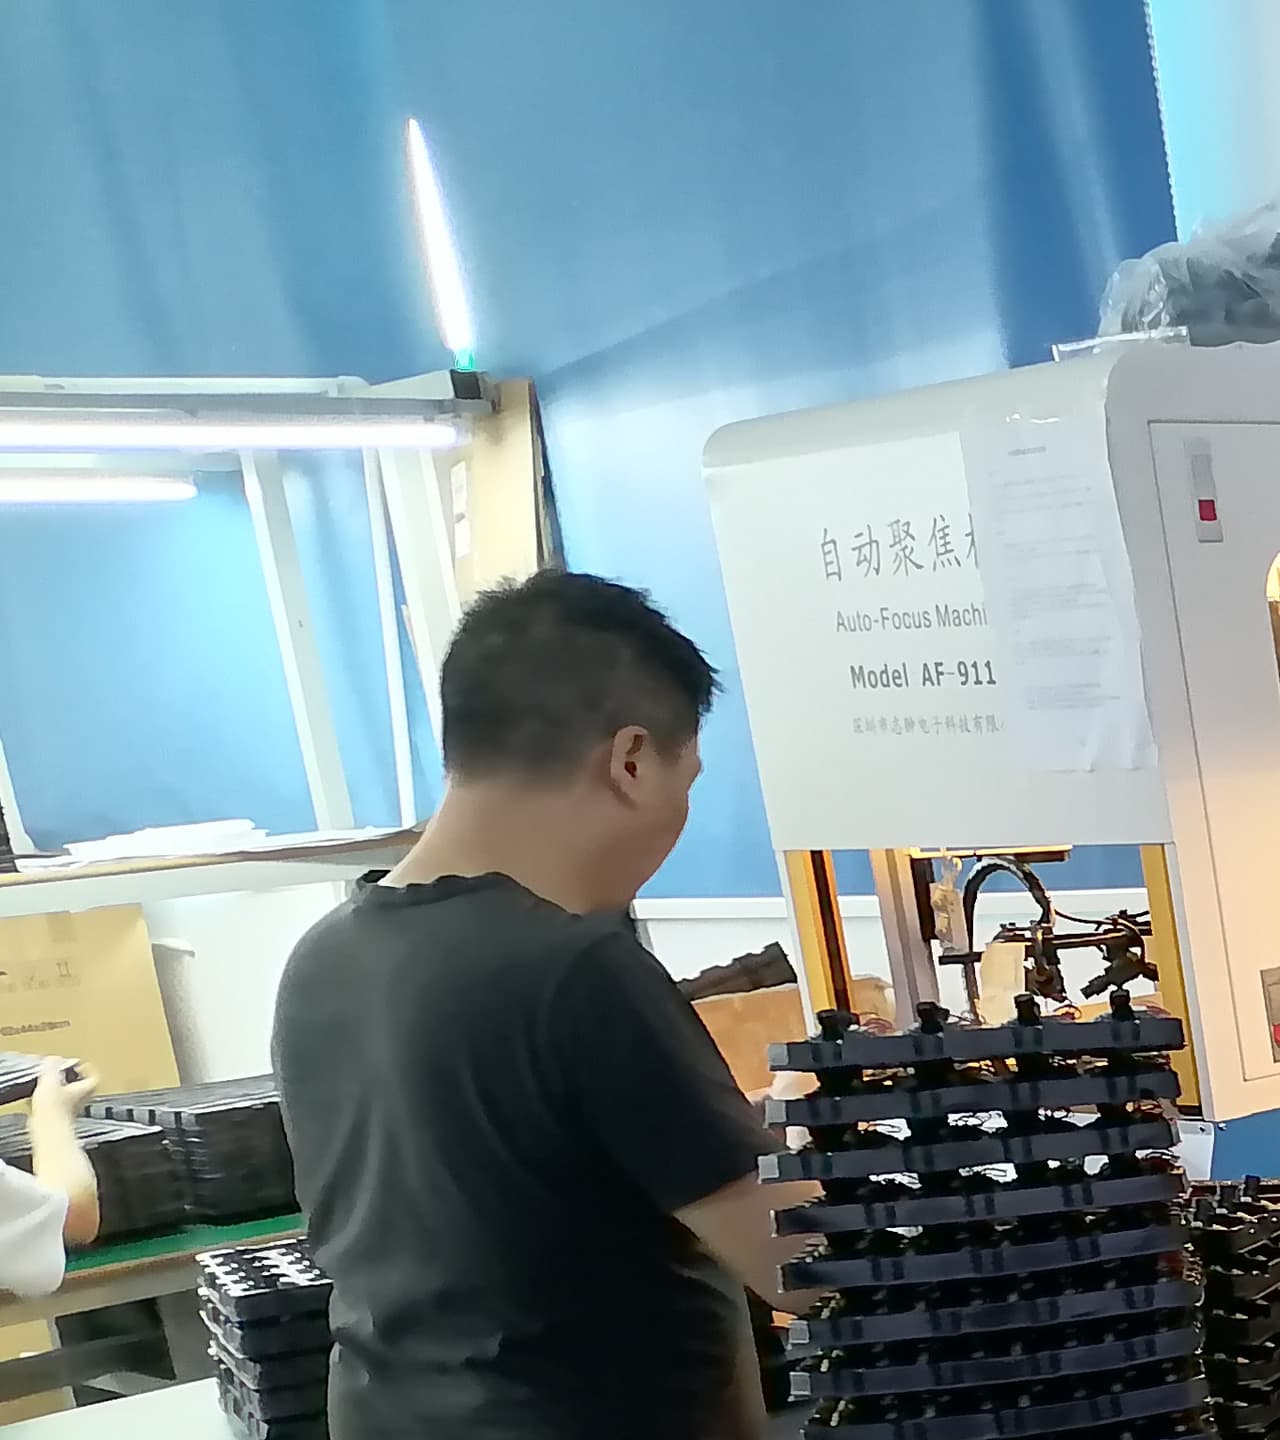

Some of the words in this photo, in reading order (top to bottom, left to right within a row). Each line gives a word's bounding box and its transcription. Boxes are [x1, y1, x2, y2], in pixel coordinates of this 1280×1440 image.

[836, 606, 932, 633] Auto-Focus
[935, 601, 988, 628] Machi
[921, 659, 997, 687] AF-911
